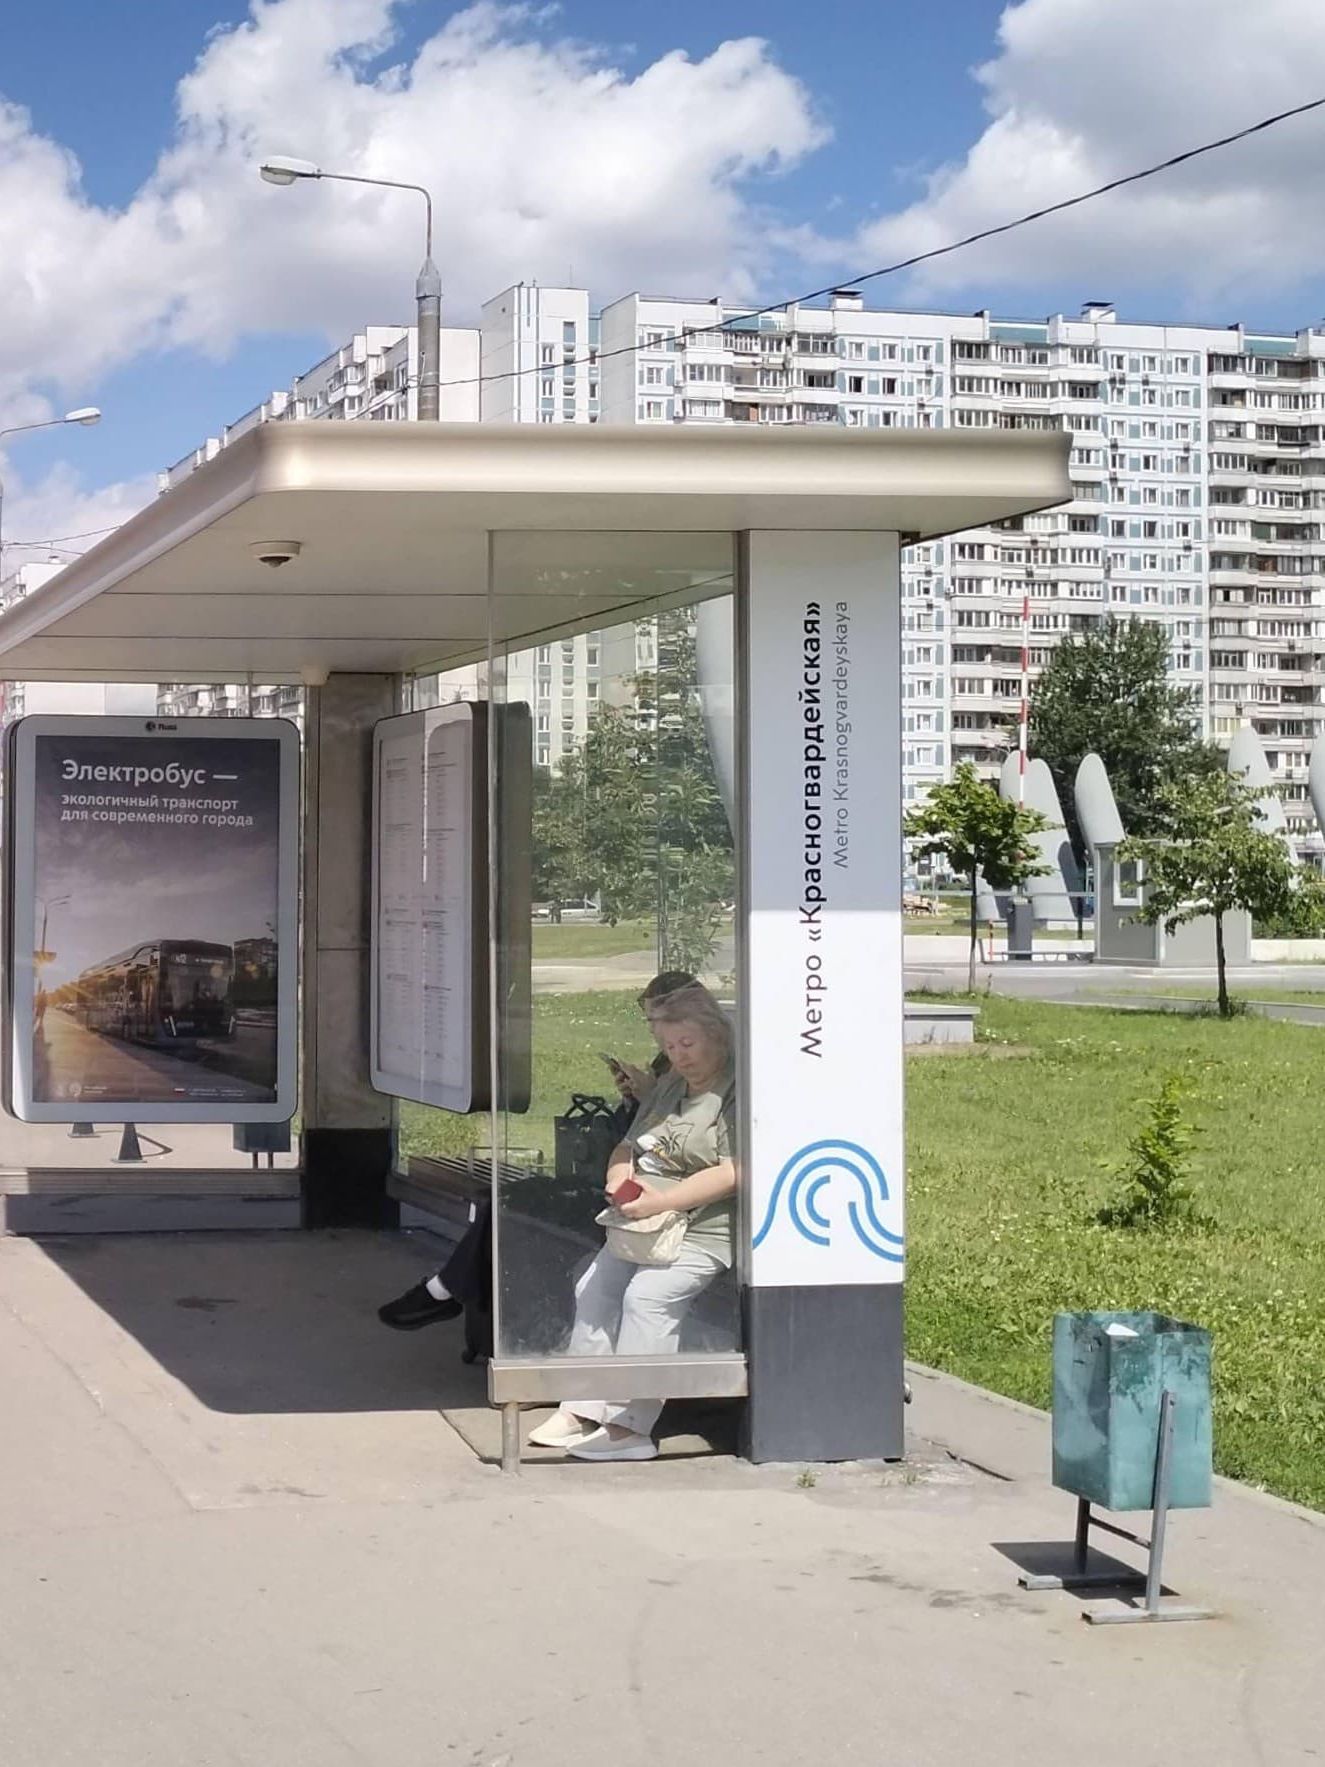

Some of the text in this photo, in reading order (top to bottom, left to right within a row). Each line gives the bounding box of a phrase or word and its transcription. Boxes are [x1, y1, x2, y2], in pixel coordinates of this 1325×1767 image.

[832, 601, 851, 868] Metro Krasnogvardeyskaya
[62, 759, 206, 788] Электробус
[61, 794, 239, 811] экологичный транспорт
[61, 809, 254, 827] для современного города
[799, 601, 827, 1058] Метро «Красногвардейская»
